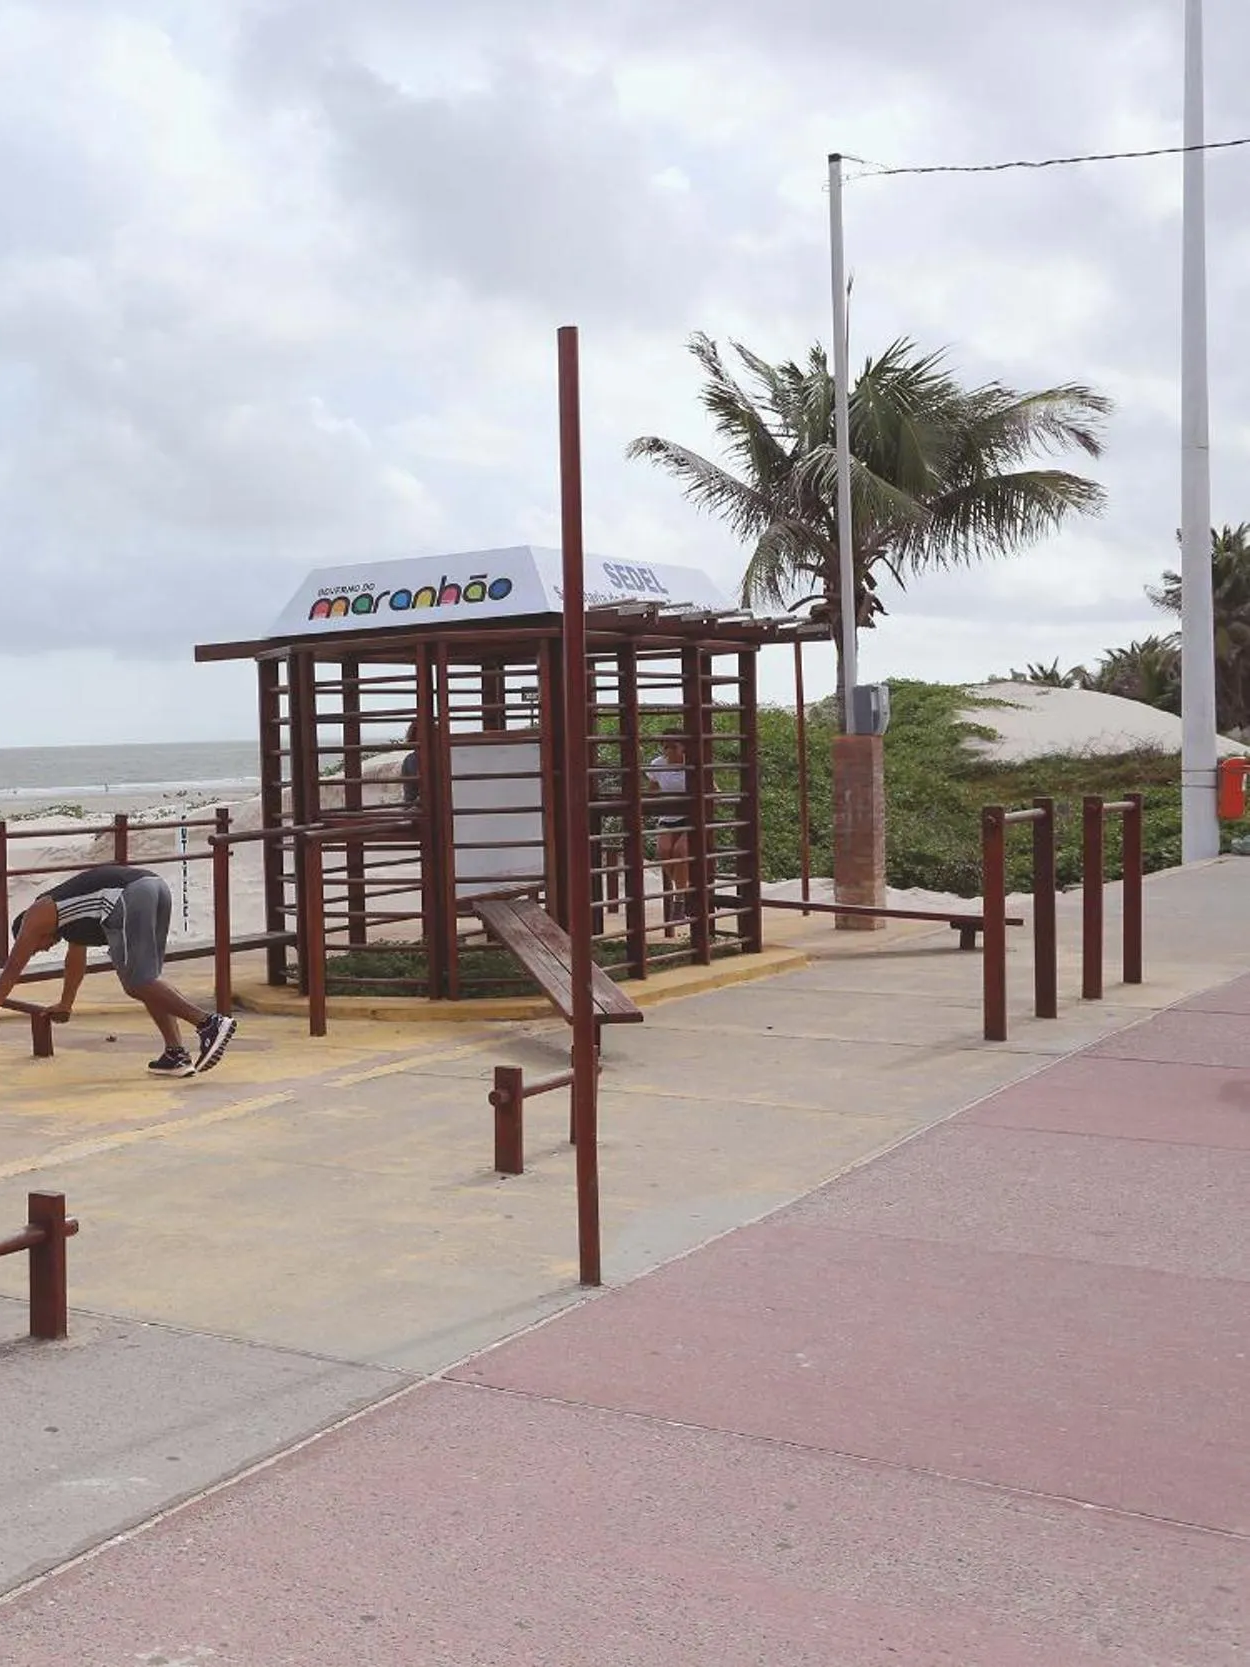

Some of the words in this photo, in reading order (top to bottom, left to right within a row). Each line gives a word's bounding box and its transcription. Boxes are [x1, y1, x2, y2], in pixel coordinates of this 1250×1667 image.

[317, 584, 360, 598] GOVERNO
[362, 582, 376, 592] DO
[602, 561, 670, 595] SEDEL
[308, 574, 513, 621] maranhão
